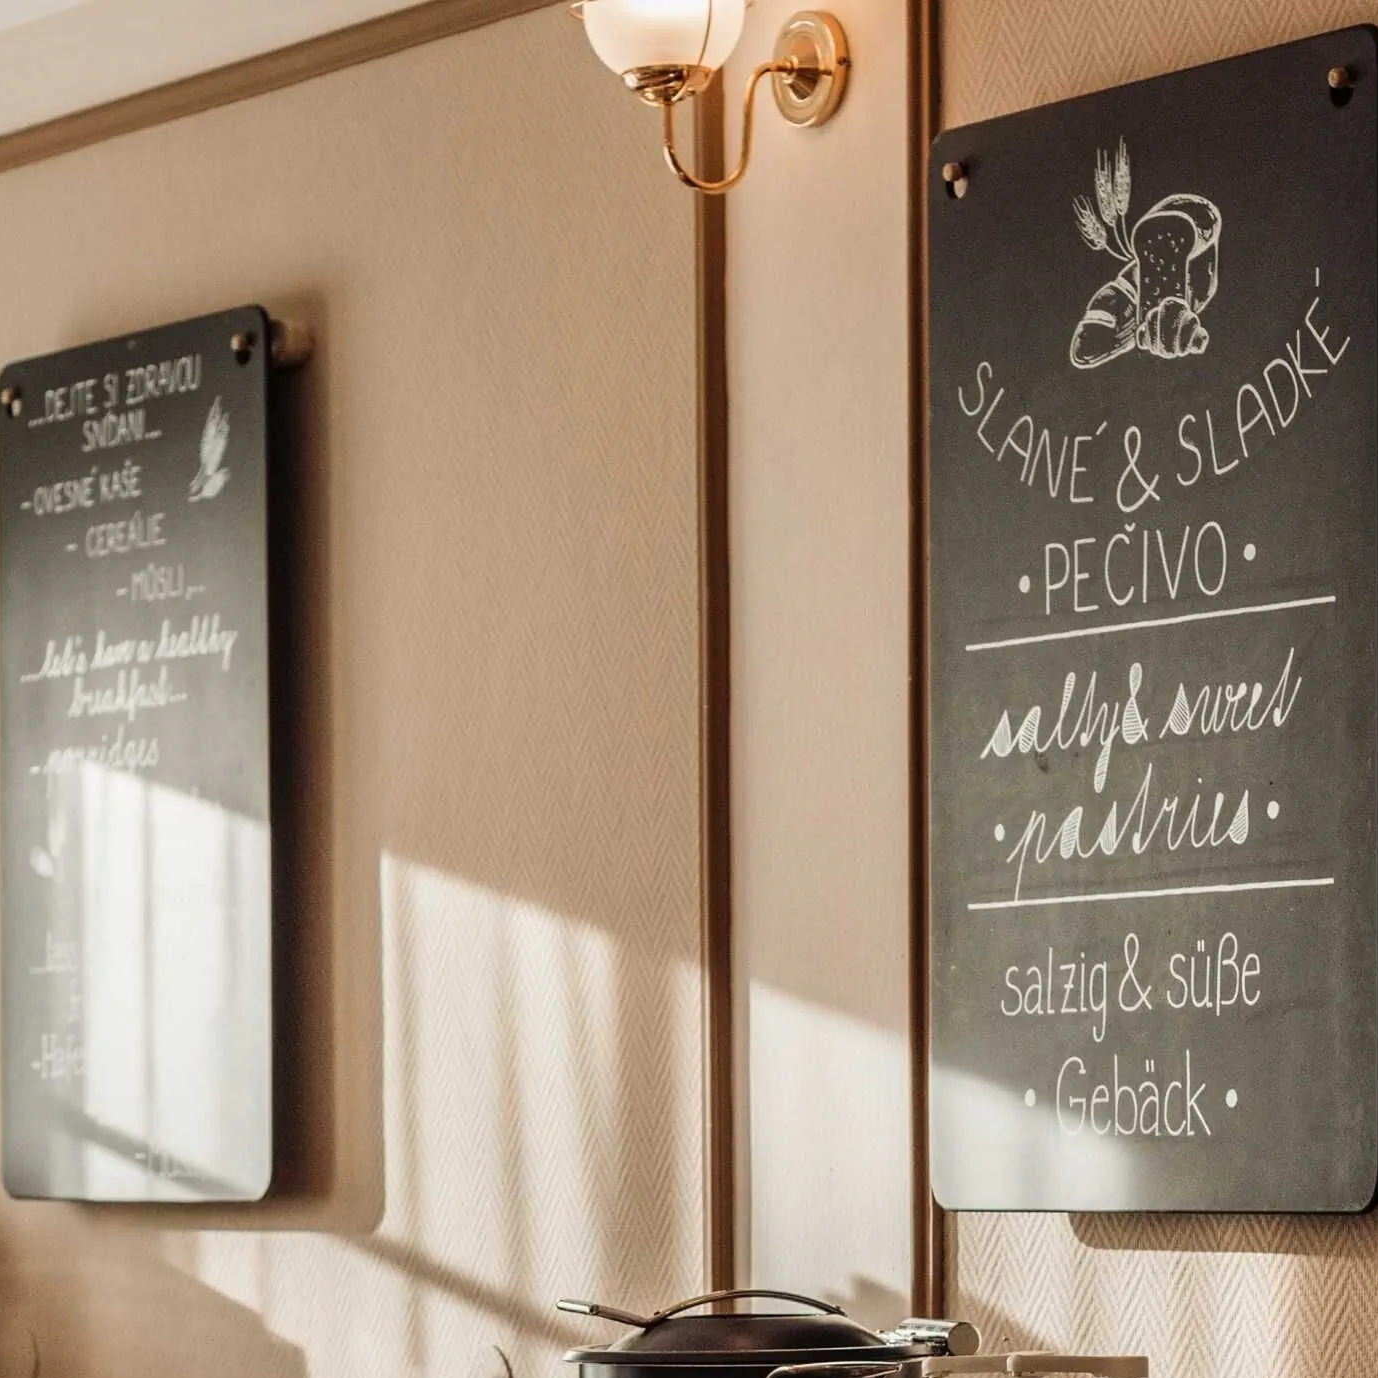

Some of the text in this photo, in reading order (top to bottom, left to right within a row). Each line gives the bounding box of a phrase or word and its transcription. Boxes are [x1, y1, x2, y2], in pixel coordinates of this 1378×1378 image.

[958, 267, 1350, 512] SLANÉ & SLADKÉ
[1045, 520, 1227, 614] PEČIVO
[980, 647, 1302, 793] salty & sweet
[1001, 932, 1262, 1042] salzig & süße
[1056, 1049, 1212, 1136] Gebäck
